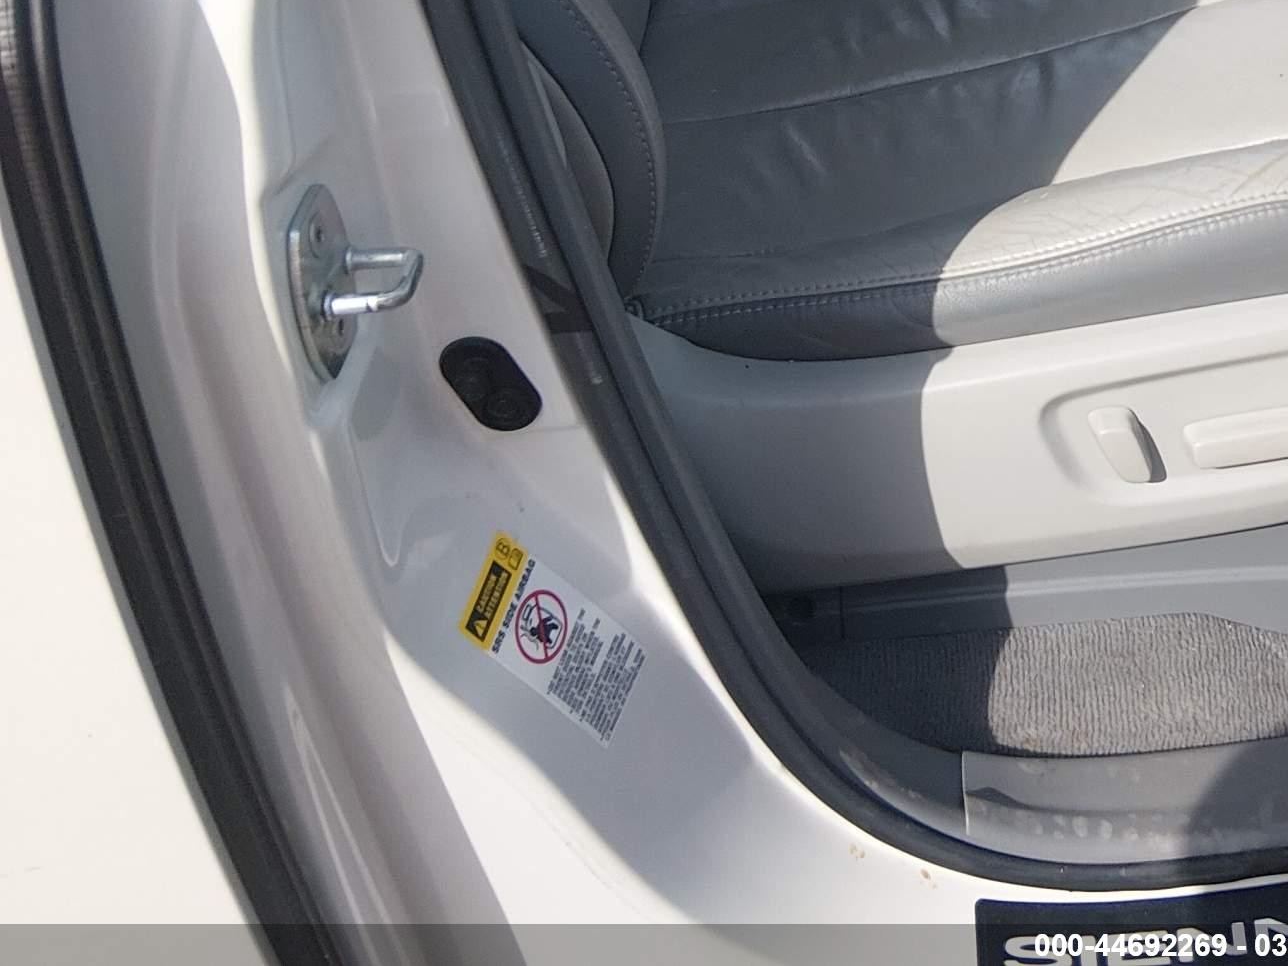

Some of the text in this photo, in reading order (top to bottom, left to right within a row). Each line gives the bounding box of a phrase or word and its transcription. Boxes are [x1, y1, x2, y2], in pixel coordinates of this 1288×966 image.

[492, 559, 536, 653] SRS SIDE AIRBAG
